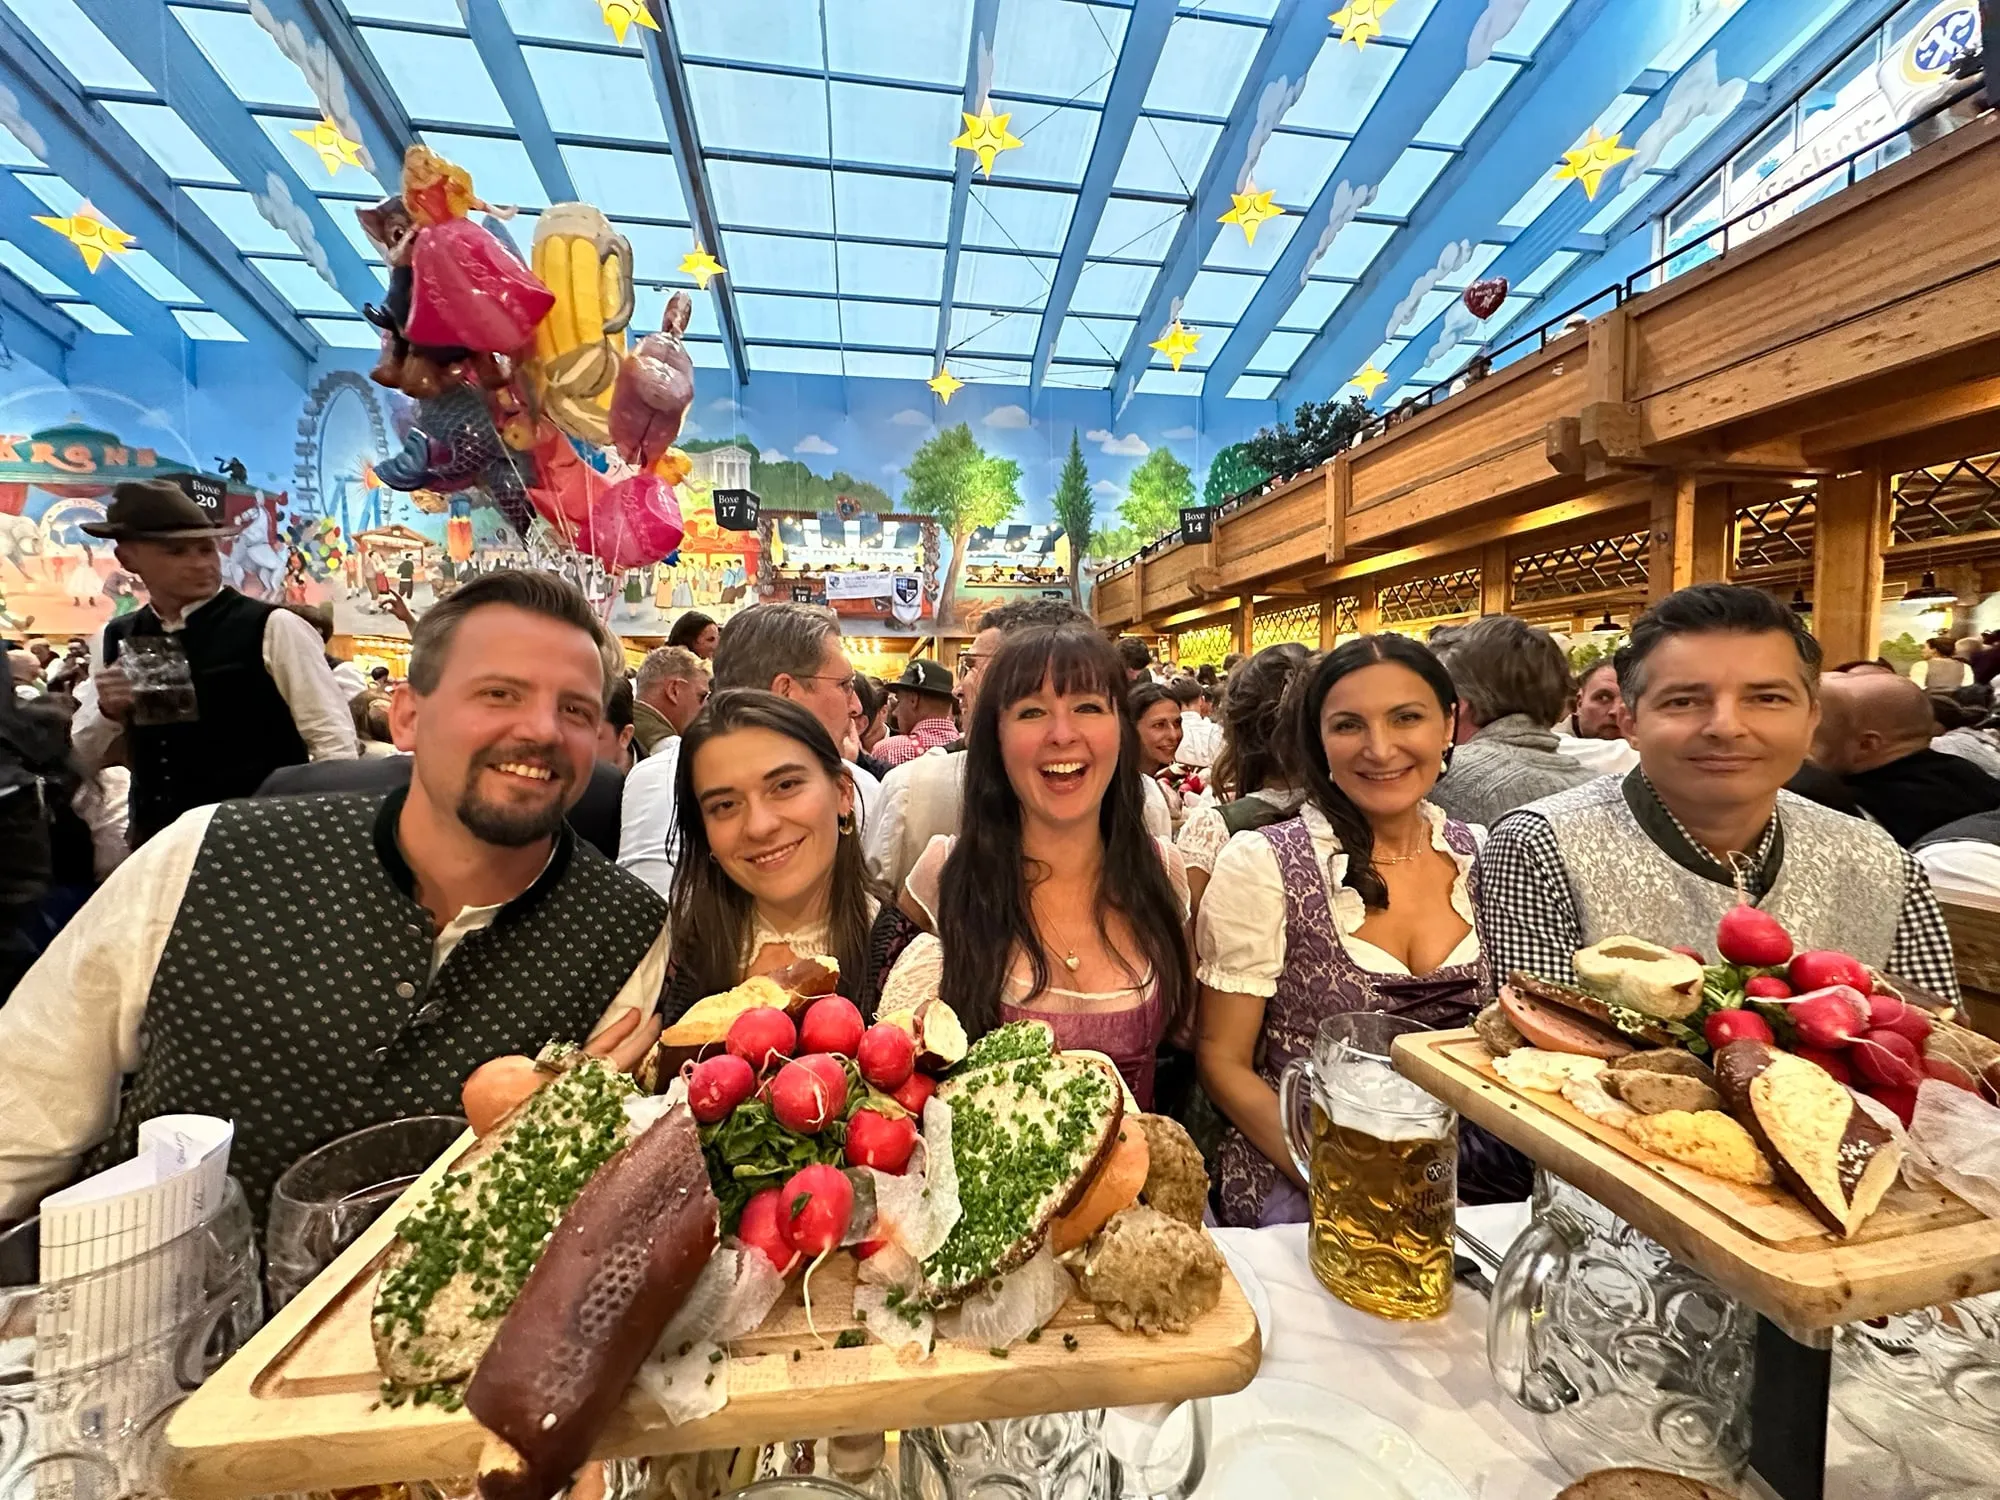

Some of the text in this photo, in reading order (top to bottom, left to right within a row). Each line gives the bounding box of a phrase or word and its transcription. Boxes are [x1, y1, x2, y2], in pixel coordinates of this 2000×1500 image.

[192, 480, 220, 495] Boxe
[196, 494, 217, 508] 20
[719, 495, 740, 504] Boxe
[722, 505, 737, 518] 17
[747, 508, 756, 522] 17
[1184, 512, 1206, 521] Boxe
[1188, 521, 1202, 533] 14
